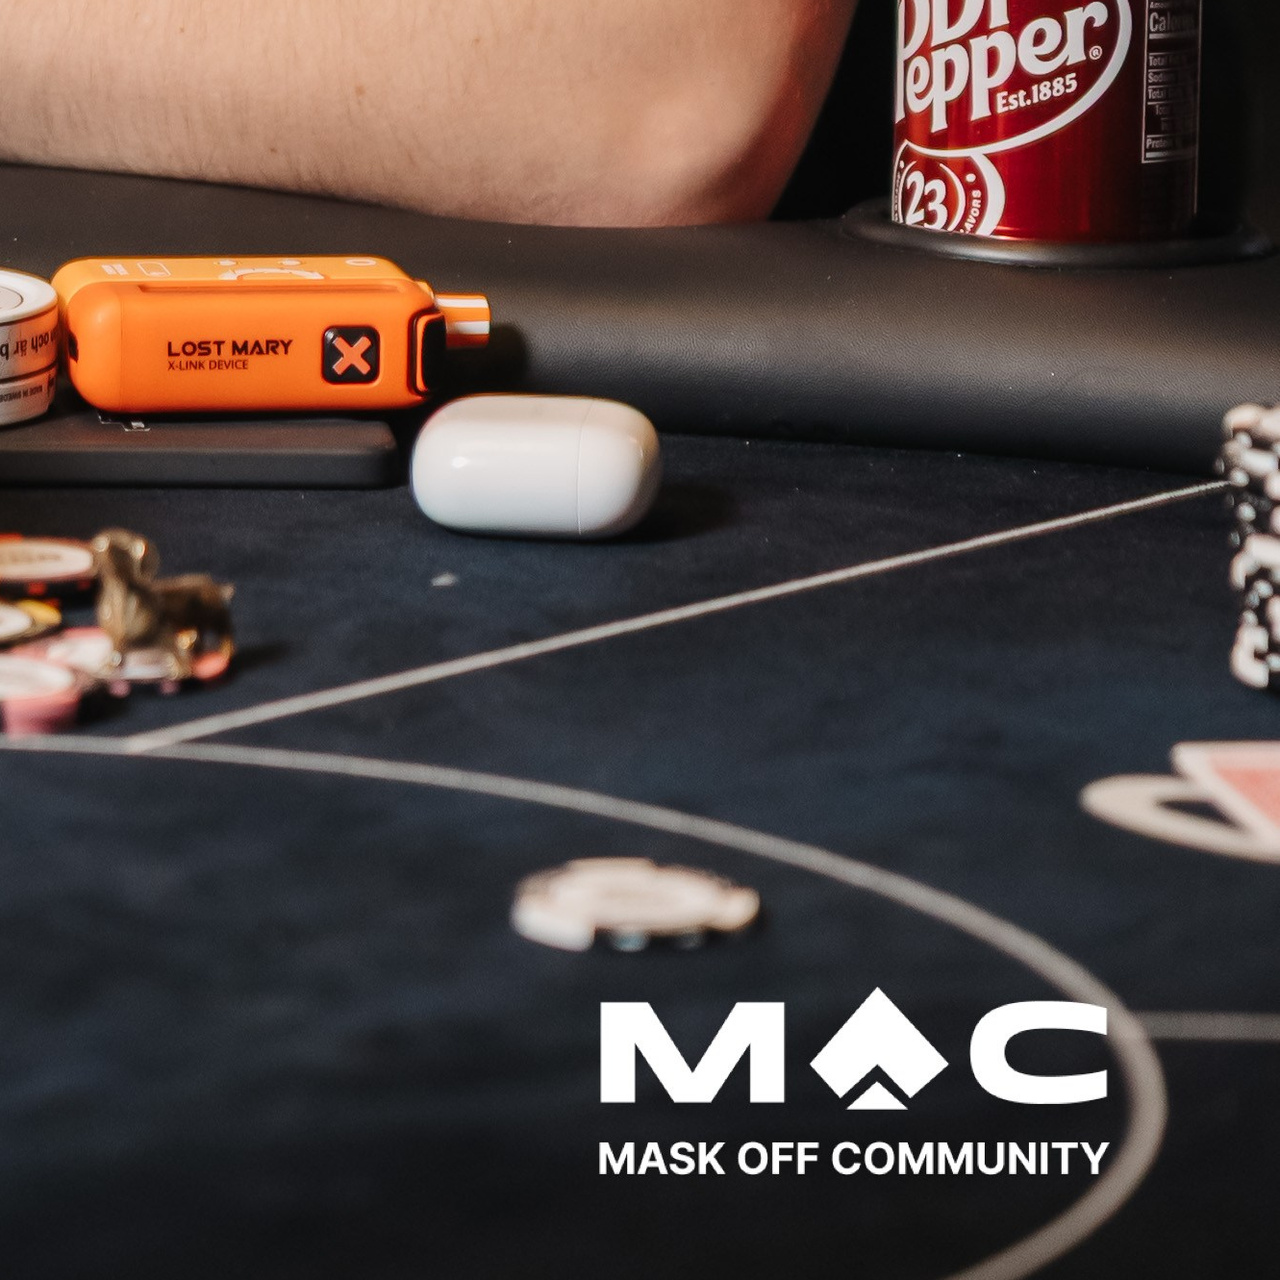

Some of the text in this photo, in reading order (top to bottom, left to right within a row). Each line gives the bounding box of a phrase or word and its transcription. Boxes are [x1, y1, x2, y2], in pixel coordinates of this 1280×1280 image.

[905, 170, 948, 230] 23
[960, 189, 982, 234] AVORS
[12, 340, 28, 356] är
[31, 332, 50, 353] och
[167, 338, 294, 357] LOST MARY
[167, 359, 249, 372] X-LINK DEVICE
